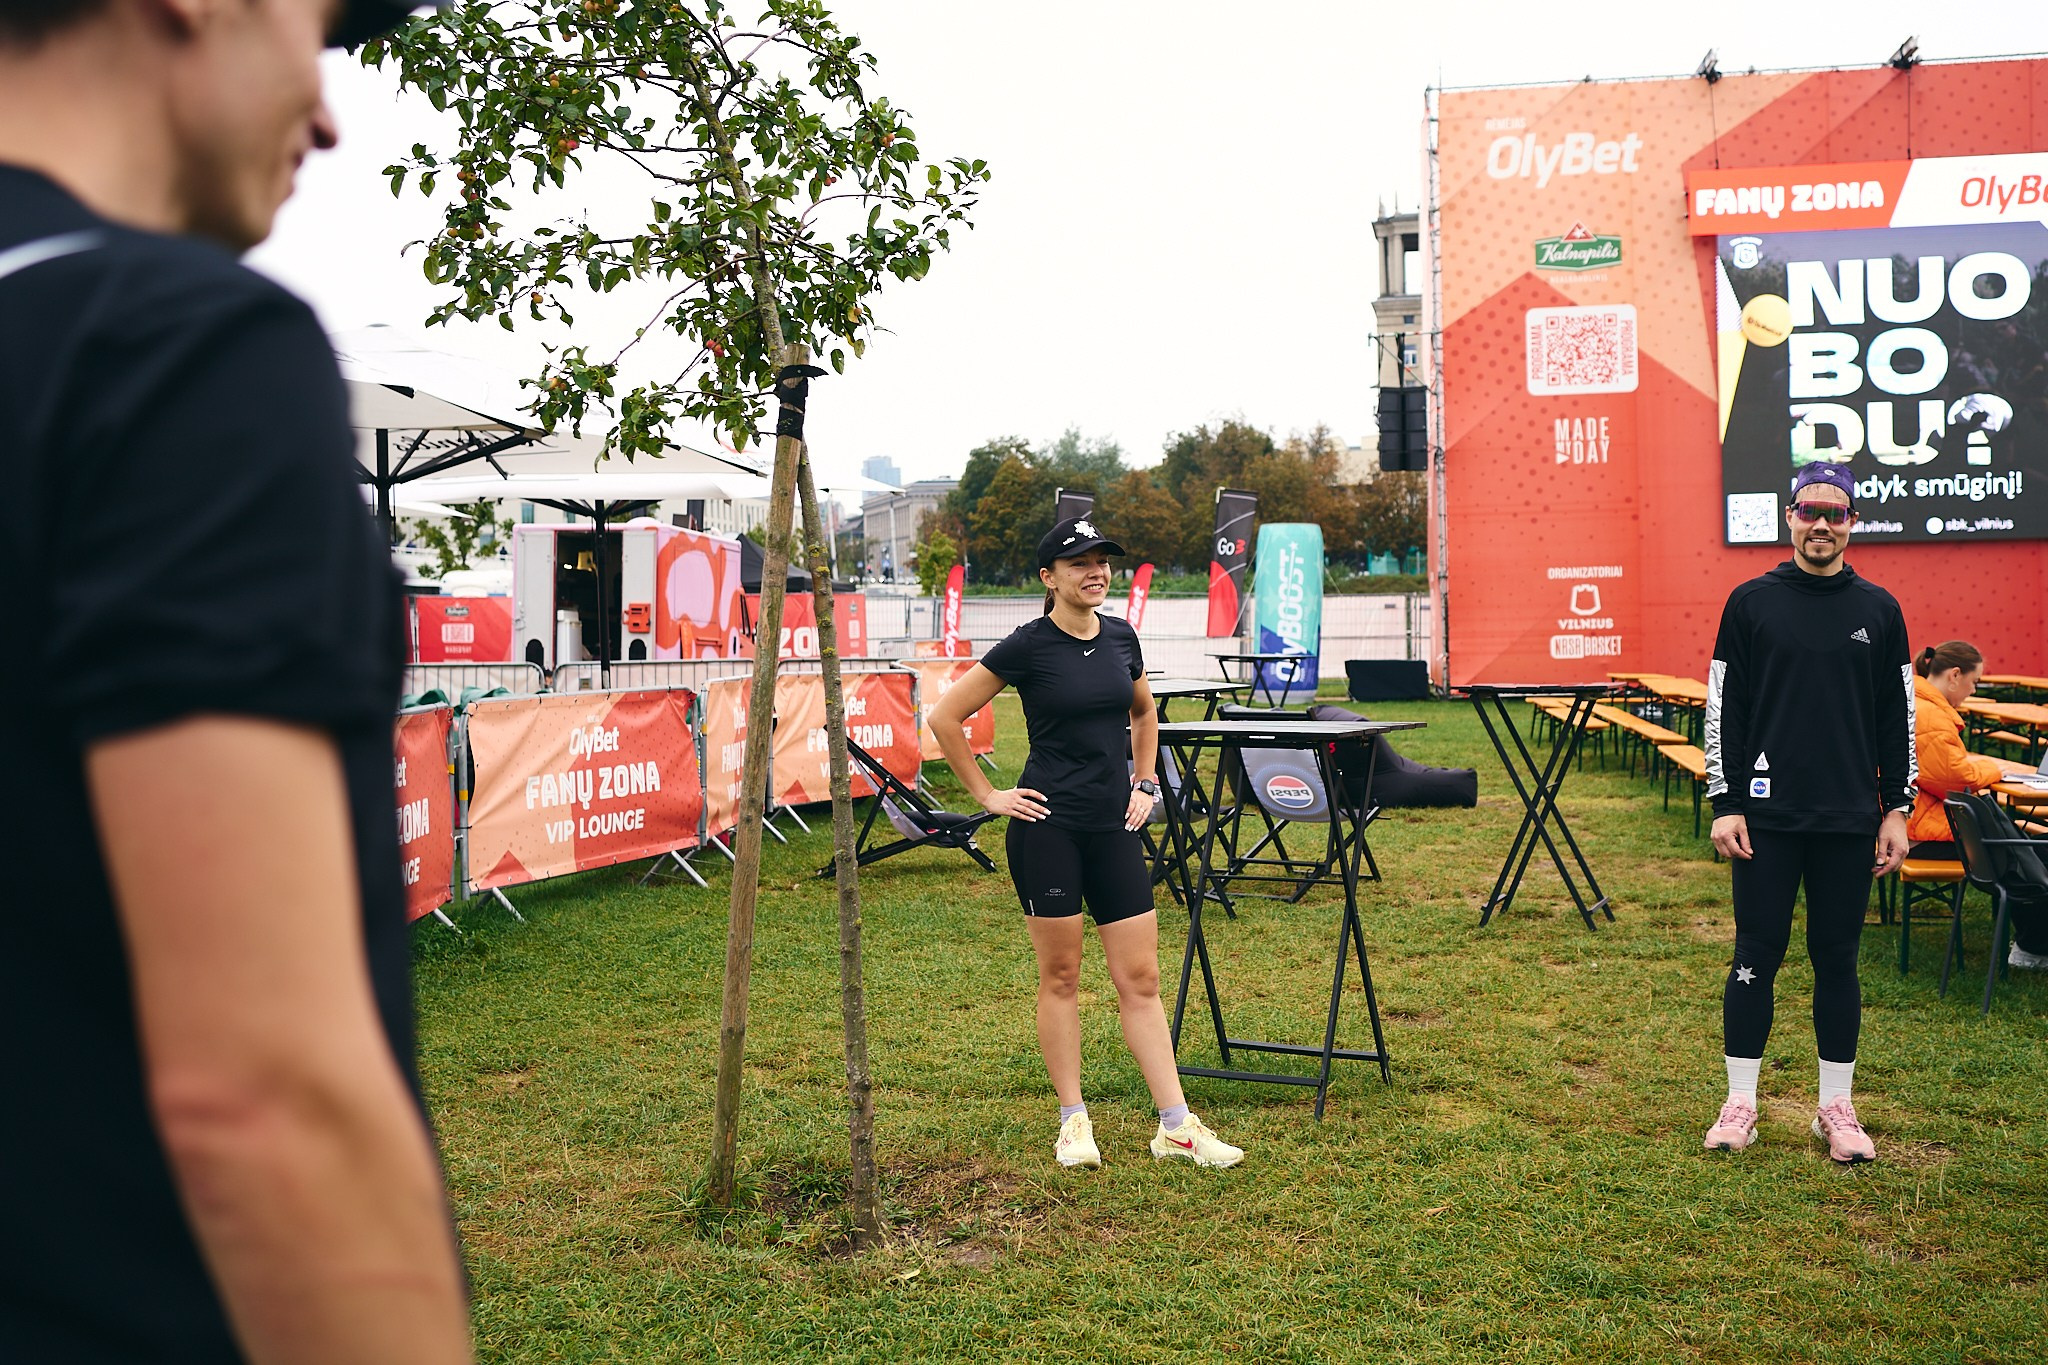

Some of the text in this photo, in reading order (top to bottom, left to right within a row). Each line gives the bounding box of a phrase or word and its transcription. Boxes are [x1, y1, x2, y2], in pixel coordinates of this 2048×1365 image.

[1487, 132, 1643, 189] OlyBet
[1695, 180, 1884, 219] FANŲ ZONA
[1961, 174, 2048, 214] OlyB
[1539, 242, 1619, 265] Kalnapilis
[1786, 252, 2031, 327] NUO
[1531, 324, 1544, 380] PROGRAMA
[1621, 319, 1634, 376] PROGRAMA
[1788, 327, 1949, 398] BO
[1555, 416, 1610, 441] MADE
[1789, 393, 2014, 468] DU?
[1573, 441, 1610, 465] DAY
[1914, 470, 2023, 502] smūginį!
[1945, 516, 2015, 532] sbk_vilnius
[1547, 565, 1623, 580] ORGANIZATORIAI
[945, 587, 960, 658] OlyBet
[1275, 548, 1307, 683] OyBOOST
[1558, 617, 1614, 630] VILNIUS
[779, 627, 820, 657] ZO
[844, 696, 867, 721] yBet
[569, 725, 620, 761] OlyBet
[853, 723, 894, 749] ZONA
[526, 761, 661, 810] FANŲ ZONA
[545, 808, 645, 844] VIP LOUNGE
